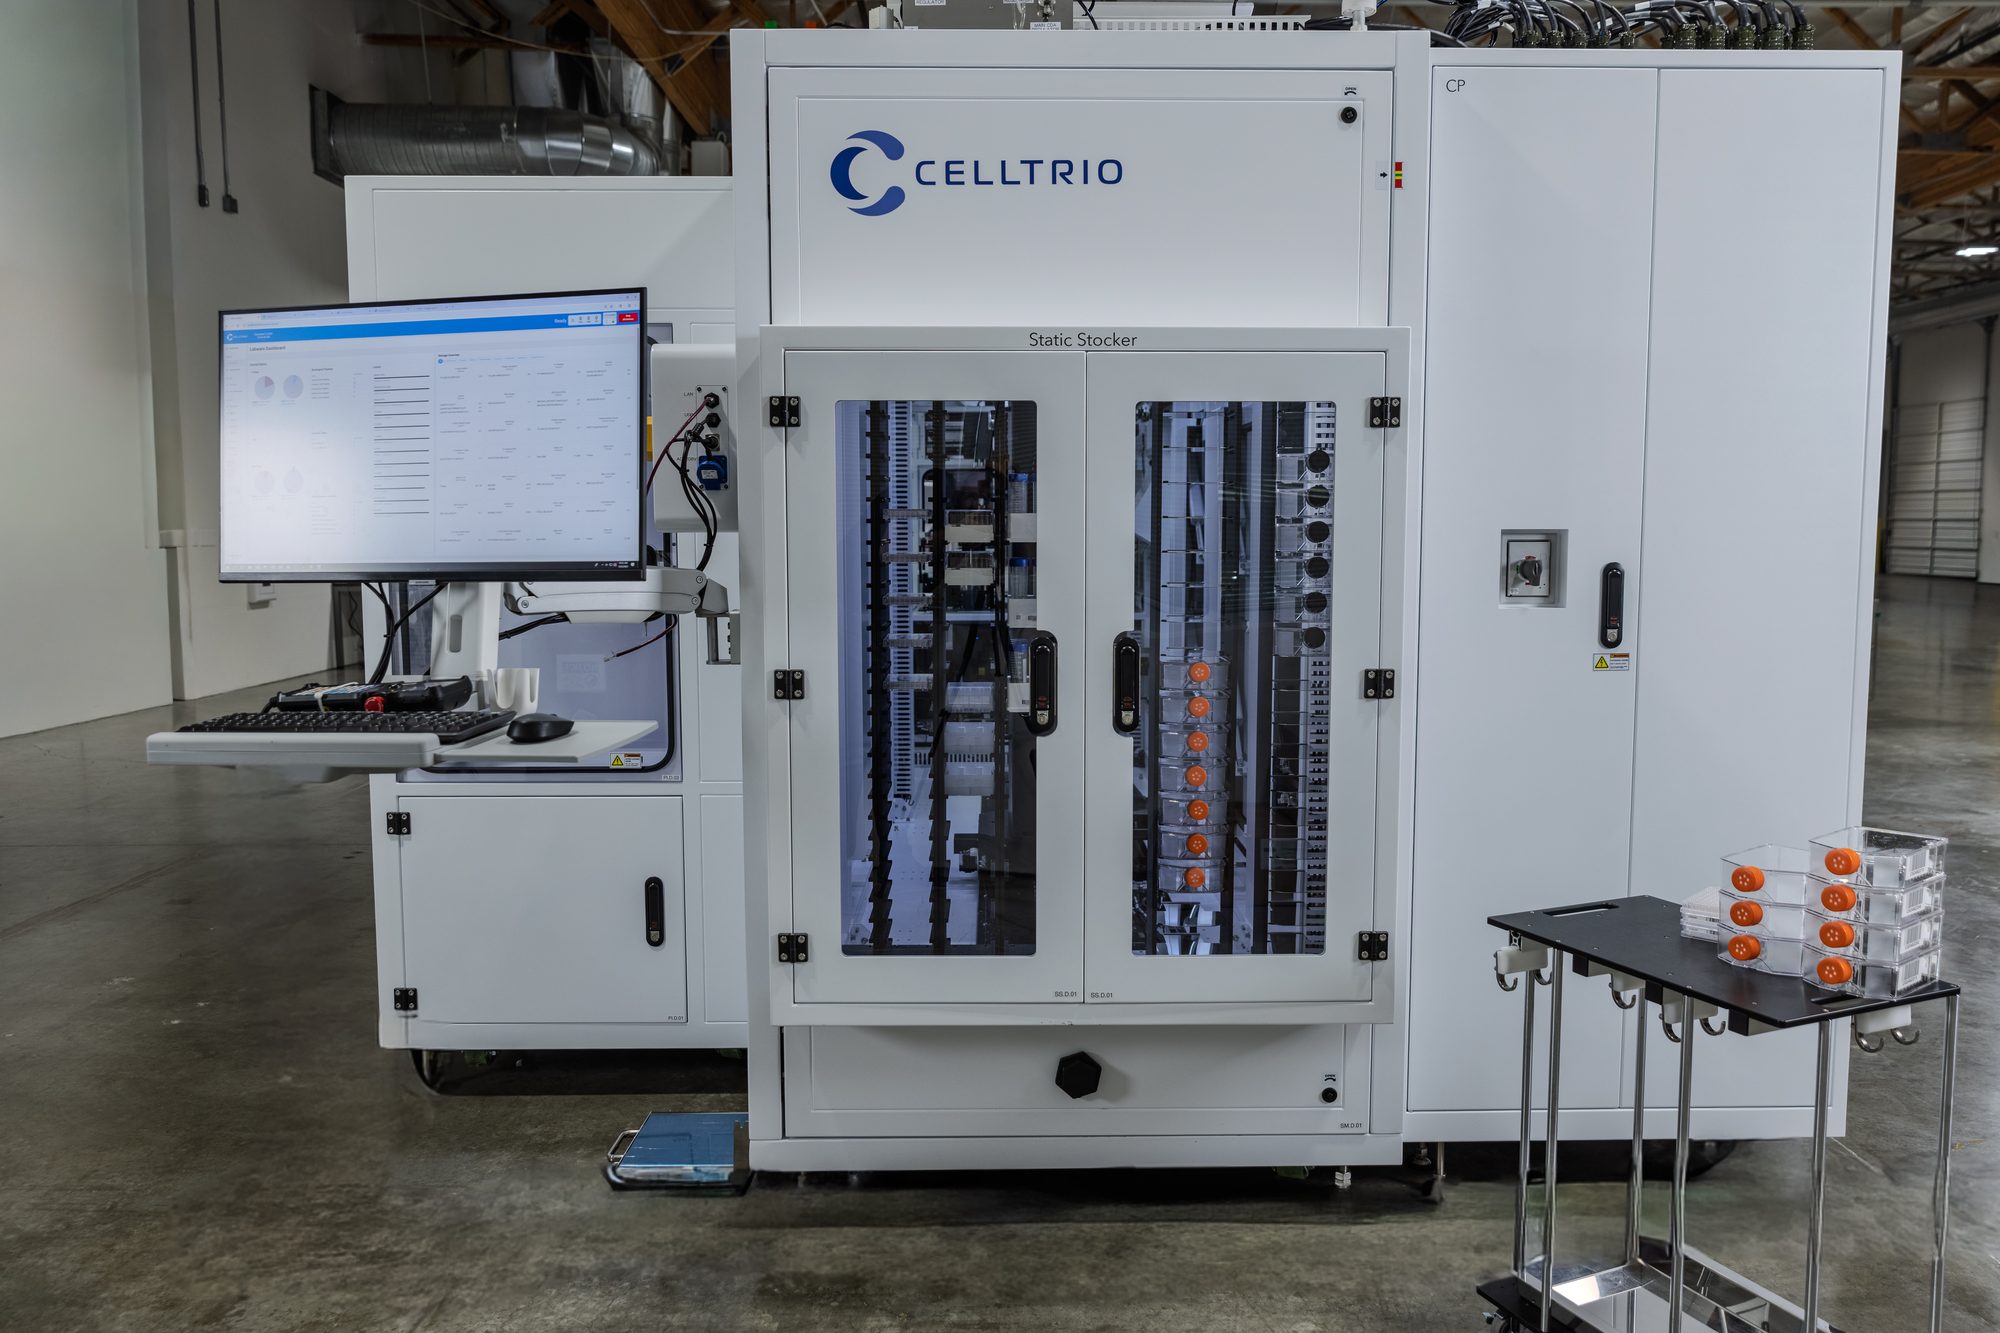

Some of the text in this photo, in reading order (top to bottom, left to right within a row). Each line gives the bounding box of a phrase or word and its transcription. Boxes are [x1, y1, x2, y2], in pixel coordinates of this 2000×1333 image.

[1445, 79, 1465, 92] CP
[915, 158, 1123, 186] CELLTRIO
[1029, 332, 1138, 346] Static Stocker
